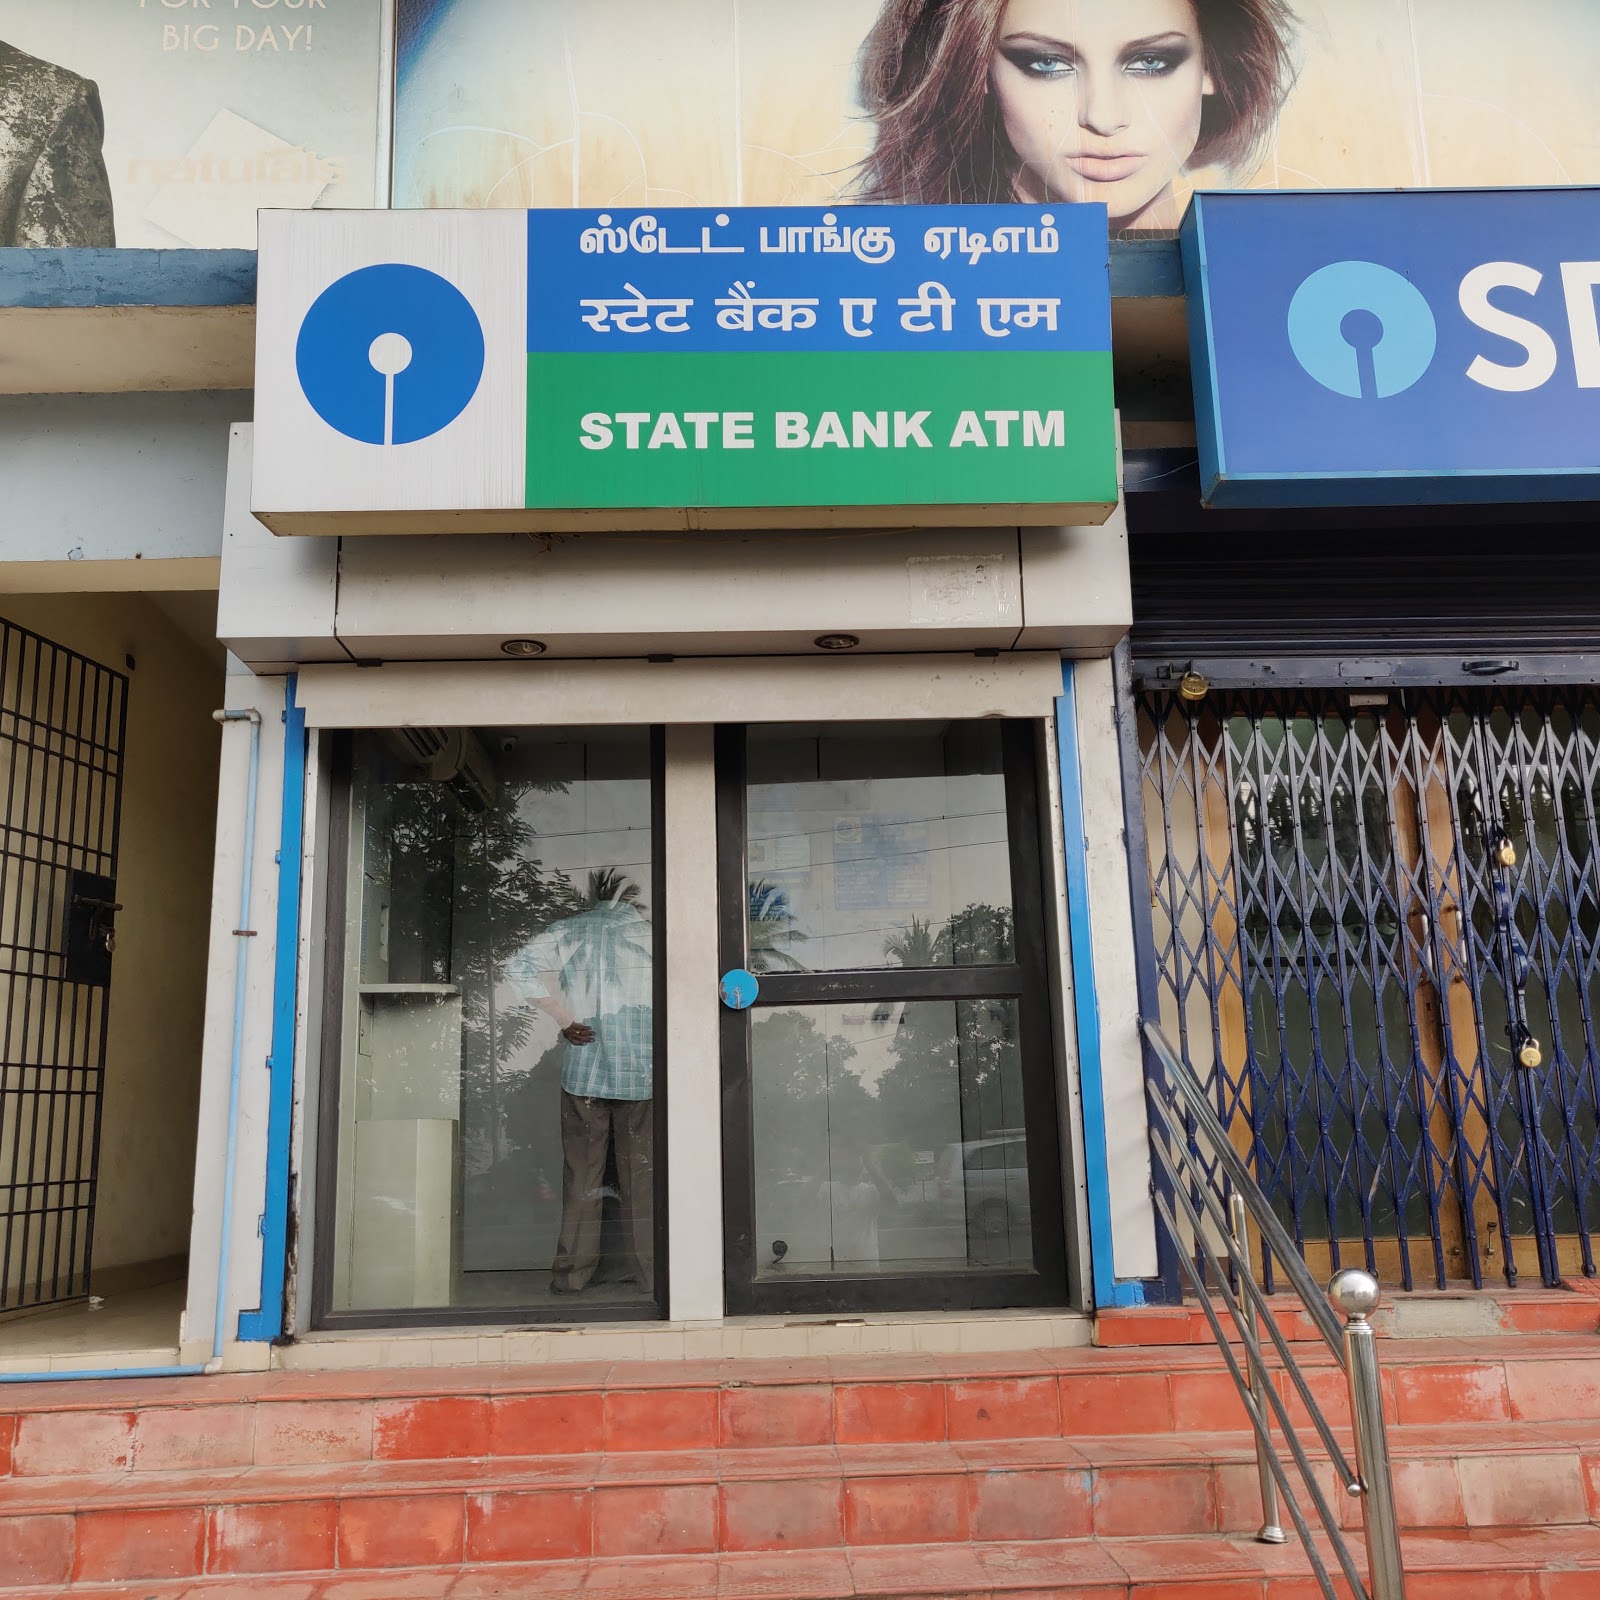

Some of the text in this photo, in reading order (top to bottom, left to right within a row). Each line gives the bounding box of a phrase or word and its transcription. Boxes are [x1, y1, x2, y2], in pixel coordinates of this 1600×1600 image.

[162, 24, 313, 52] BIG DAY!
[579, 212, 1059, 265] ஸ்டேட் பாங்கு ஏடிஎம்
[579, 280, 1061, 338] स्टेट बैंक ए टी एम
[579, 410, 1065, 450] STATE BANK ATM
